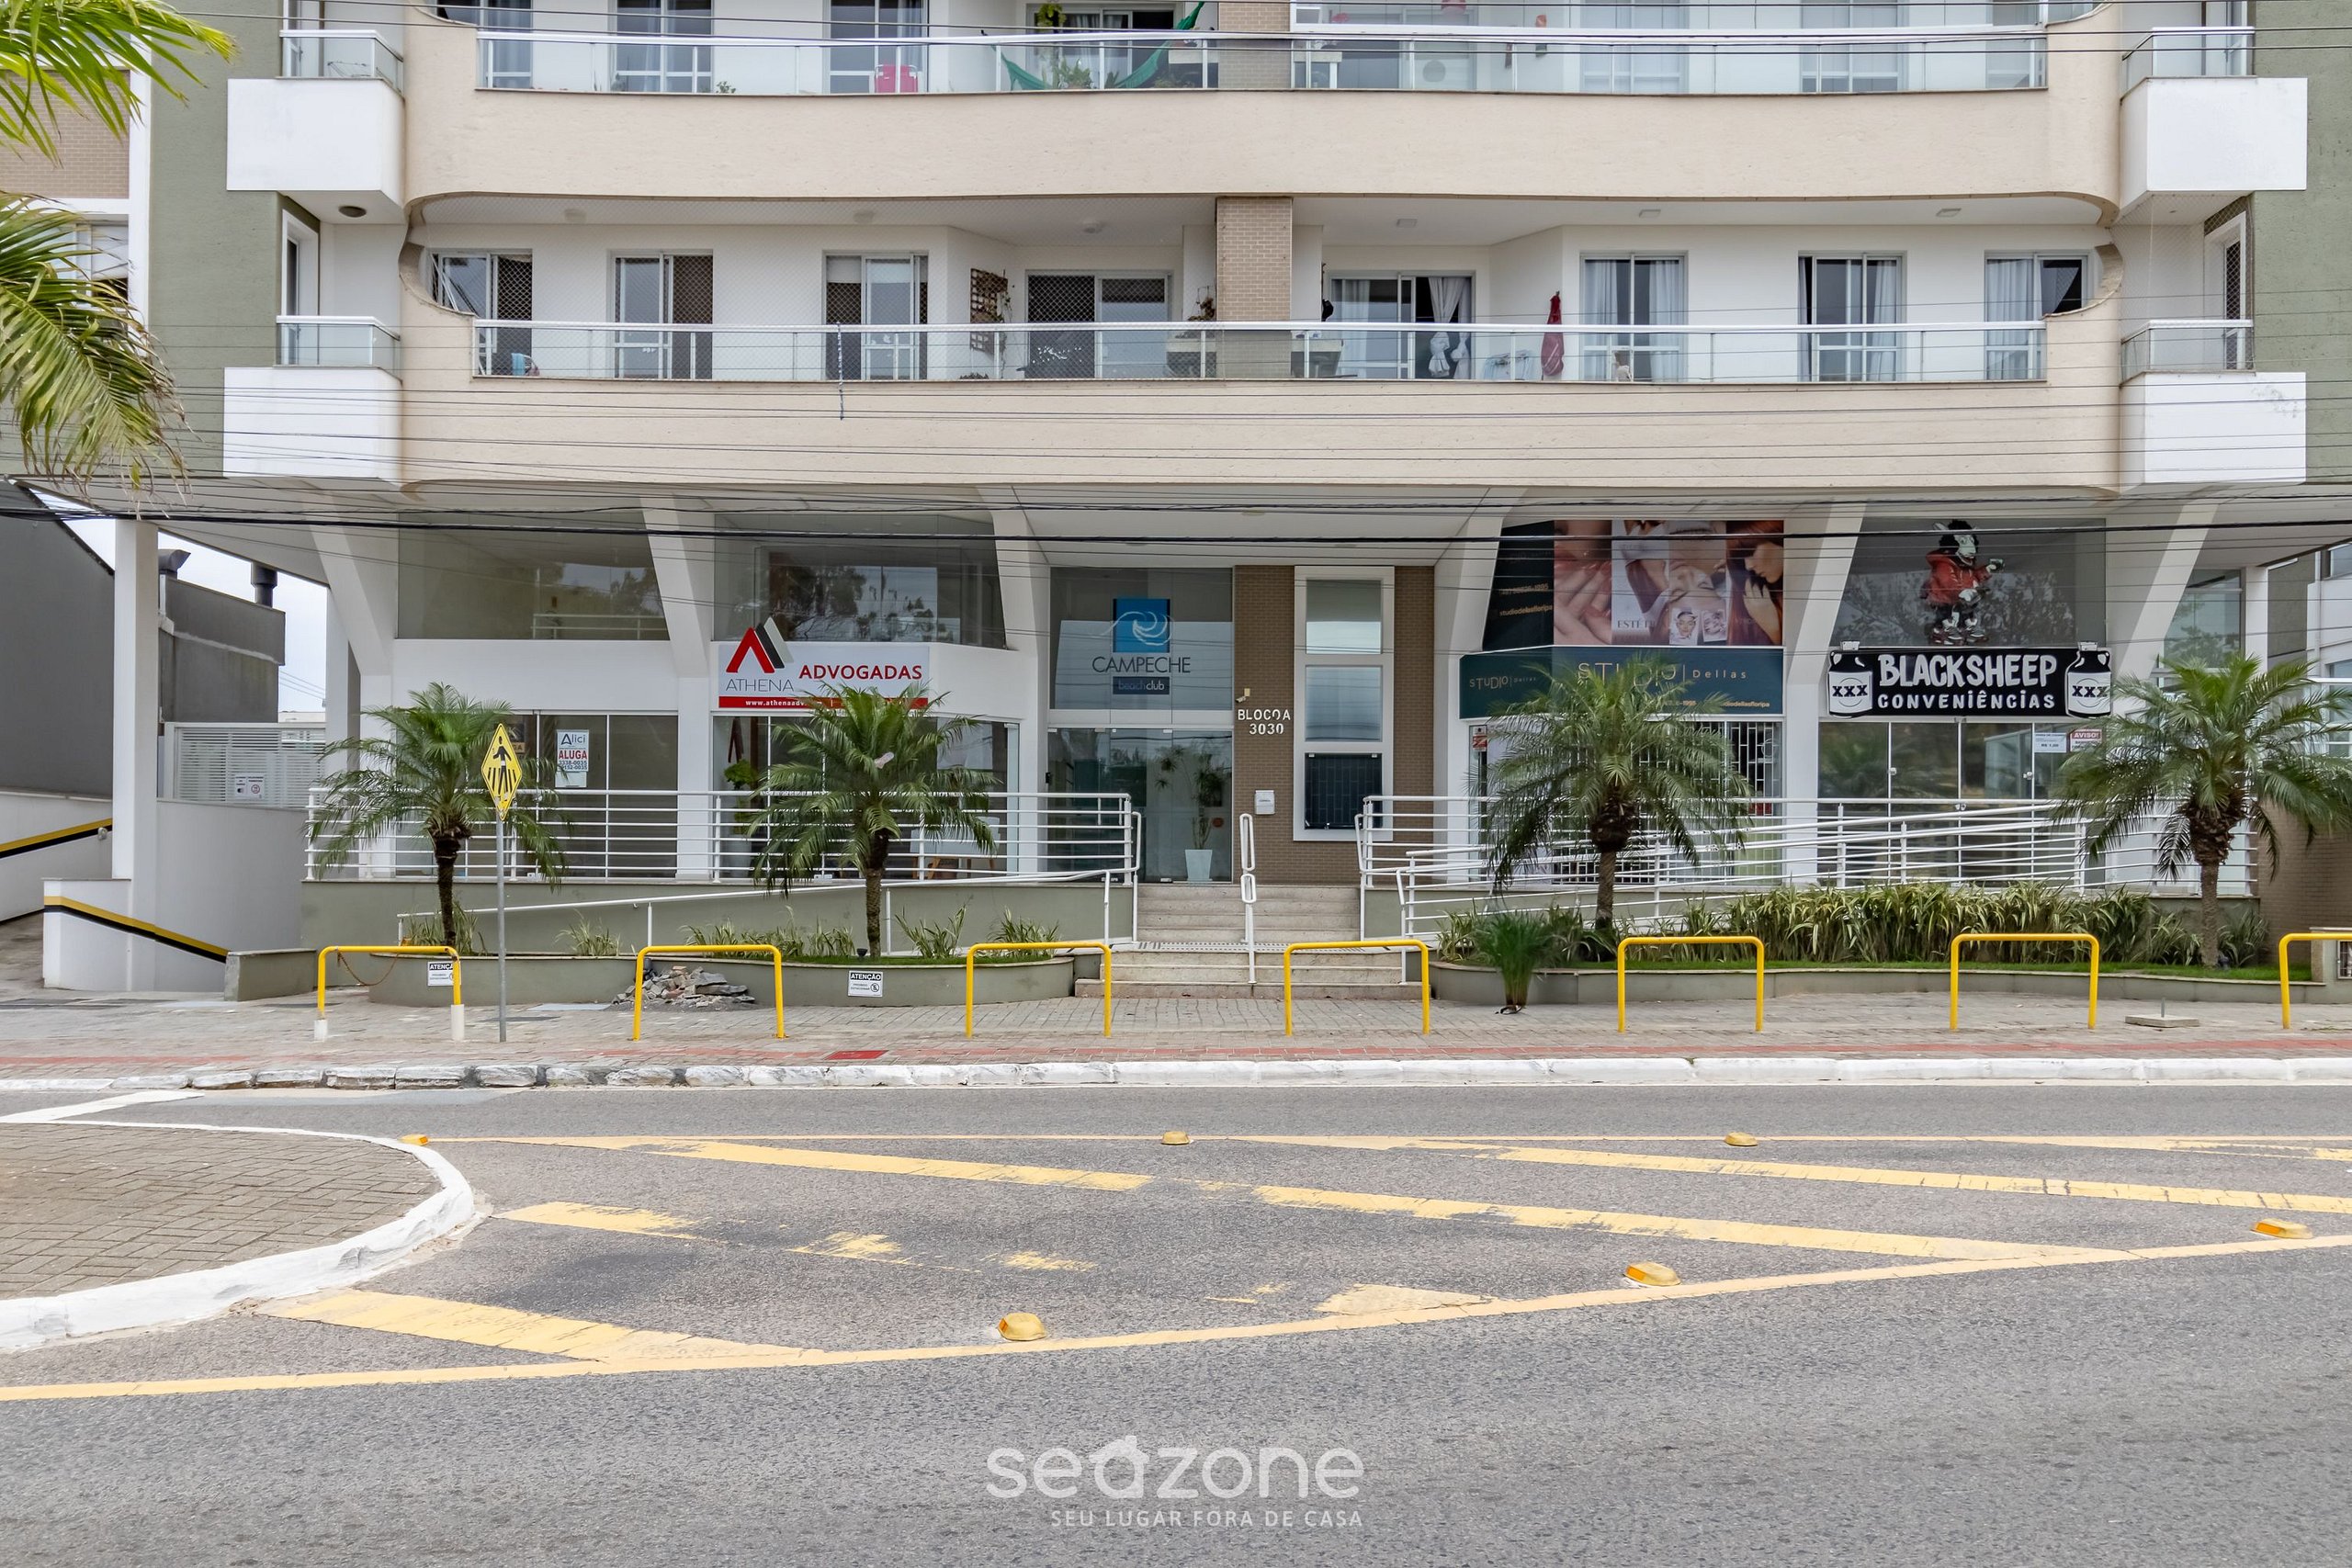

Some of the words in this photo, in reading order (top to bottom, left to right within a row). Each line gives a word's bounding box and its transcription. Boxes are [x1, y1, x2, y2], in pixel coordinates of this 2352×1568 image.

[798, 664, 922, 680] ADVOGADAS
[1091, 657, 1191, 673] CAMPECHE
[1878, 654, 2058, 687] BLACKSHEEP
[1692, 669, 1747, 679] Dellas
[725, 678, 794, 692] ATHENA
[1146, 680, 1165, 691] club
[1469, 675, 1509, 691] STUDIO
[1877, 690, 2056, 709] CONVENIÊNCIAS
[1238, 709, 1280, 720] BLOCO
[1249, 723, 1284, 735] 3030
[559, 750, 588, 760] ALUGA
